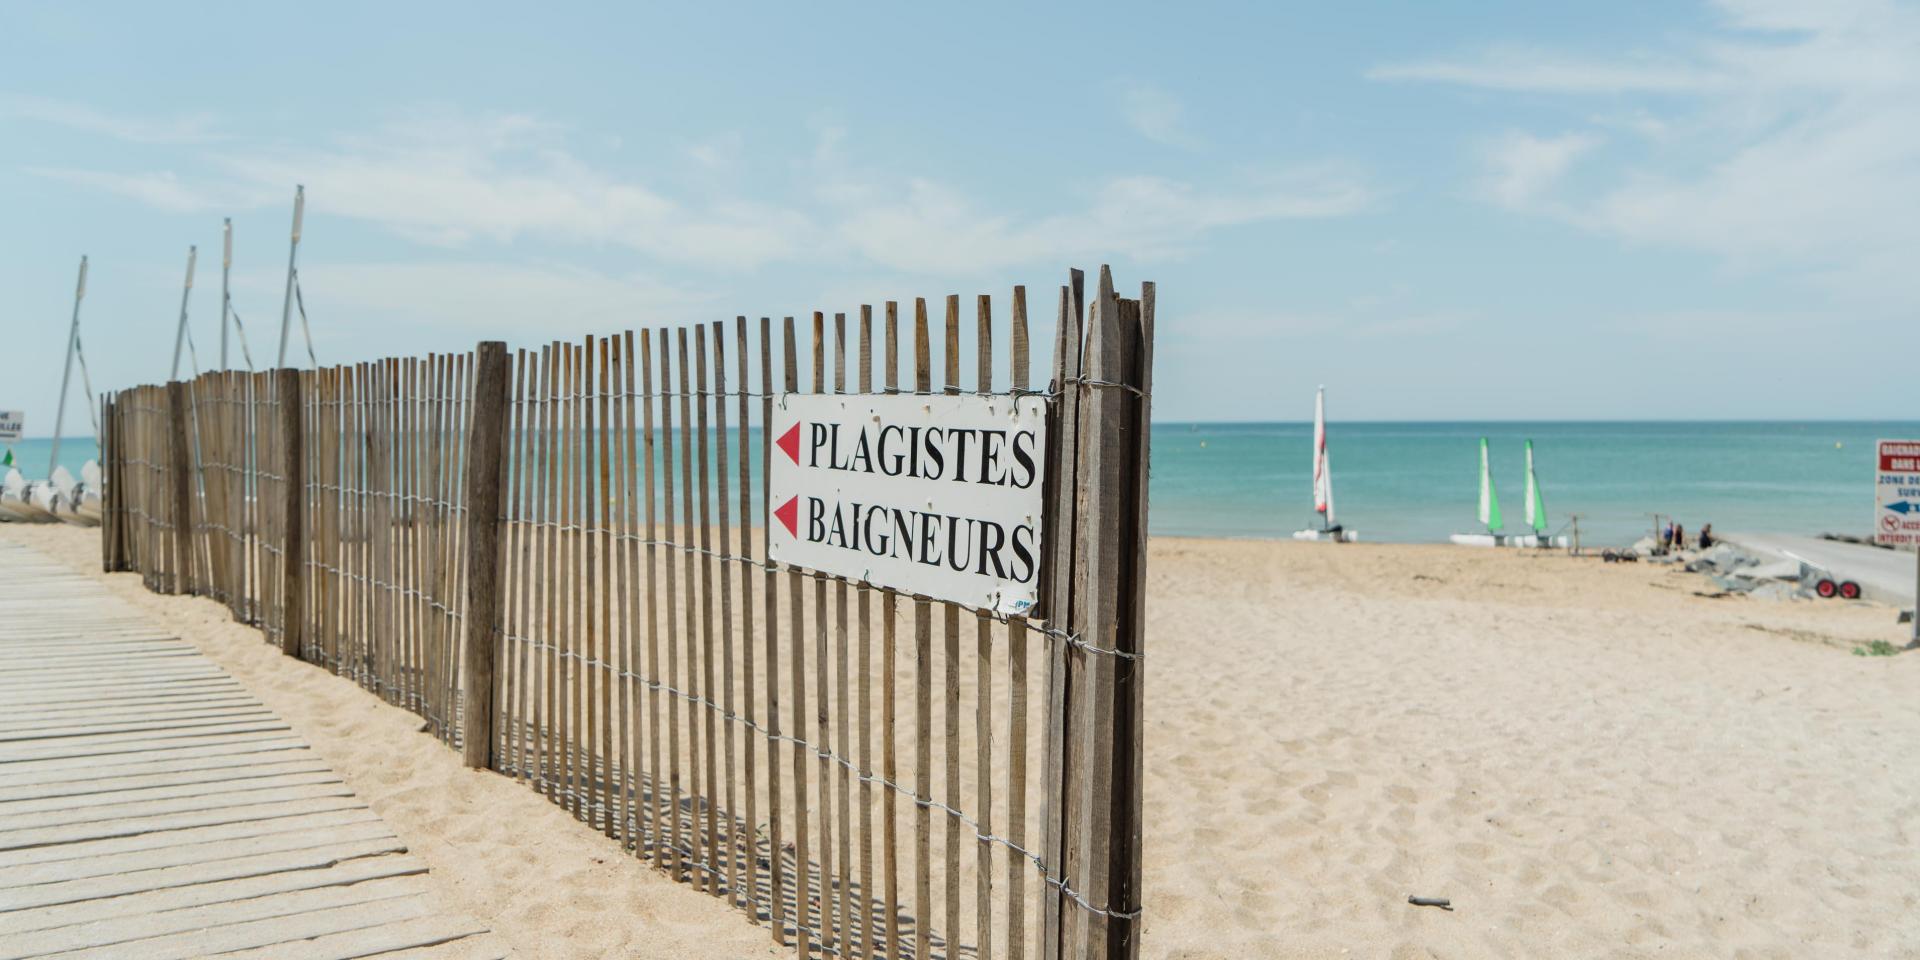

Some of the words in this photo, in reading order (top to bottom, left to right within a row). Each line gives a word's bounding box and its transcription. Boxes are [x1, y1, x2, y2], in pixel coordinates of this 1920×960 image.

[808, 422, 1037, 490] PLAGISTES
[1882, 445, 1920, 456] BAIGNAD
[1891, 458, 1914, 470] DANS
[1879, 475, 1904, 485] ZONE
[807, 496, 1035, 584] BAIGNEURS
